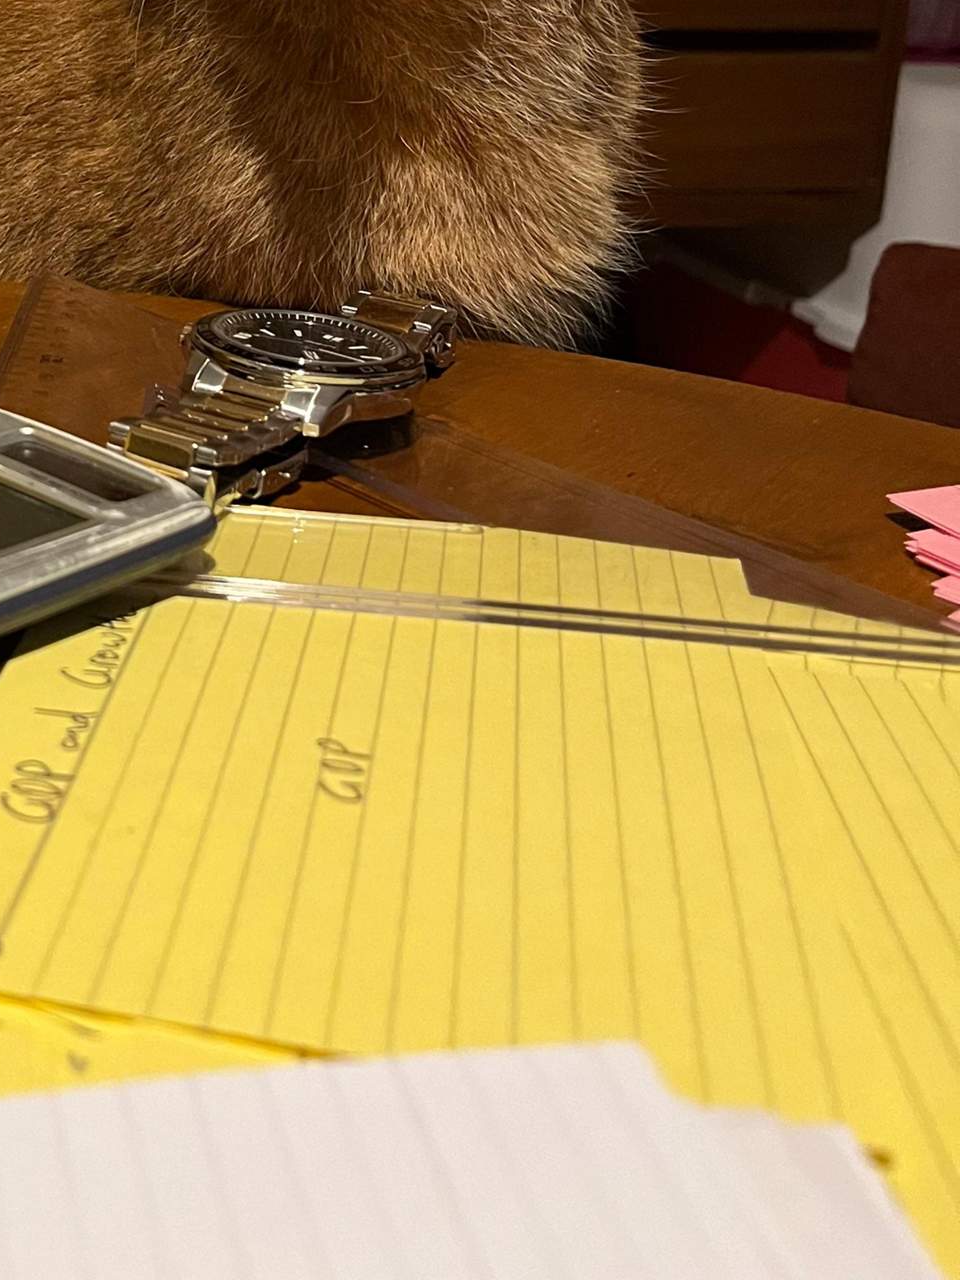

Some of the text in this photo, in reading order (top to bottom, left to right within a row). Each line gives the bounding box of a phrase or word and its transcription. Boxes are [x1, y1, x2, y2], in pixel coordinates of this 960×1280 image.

[34, 706, 99, 751] and
[1, 759, 74, 824] GDP
[317, 737, 372, 804] GDP
